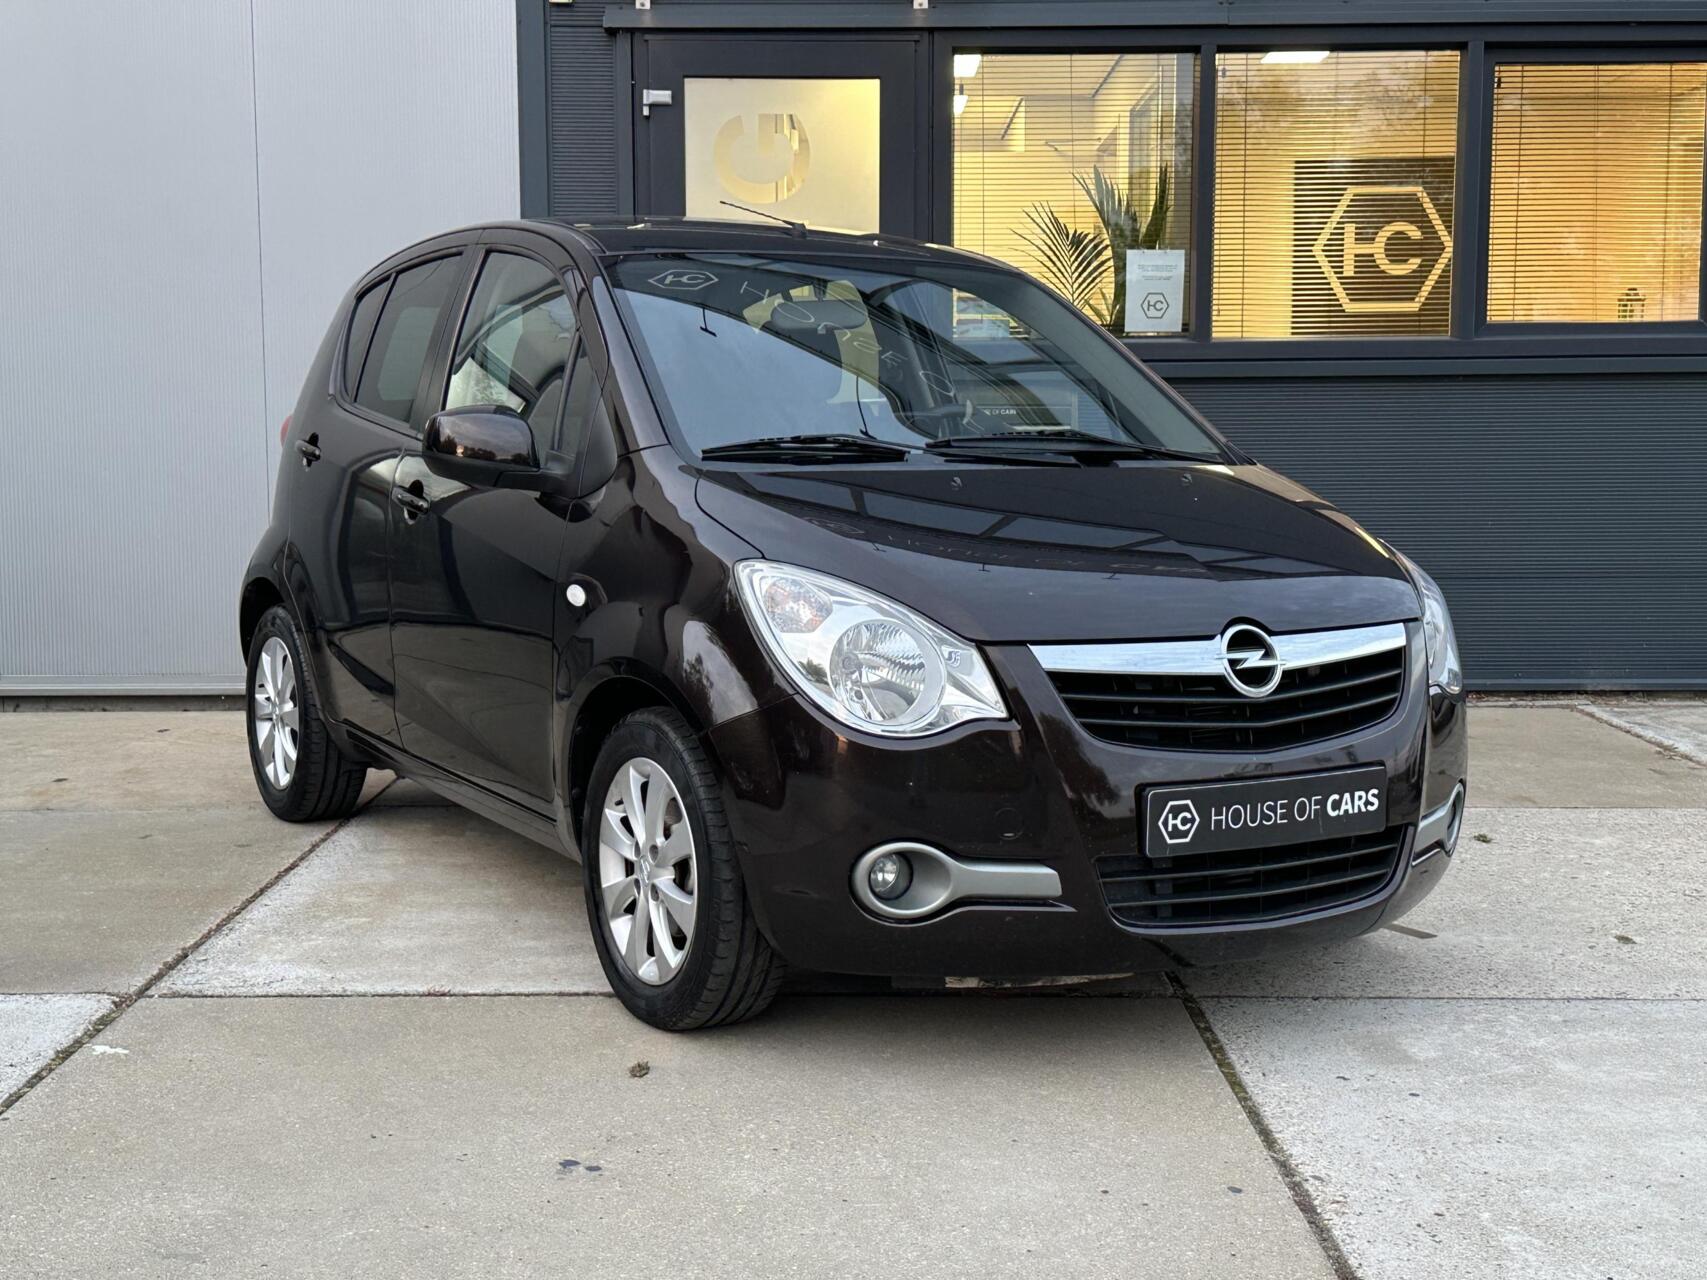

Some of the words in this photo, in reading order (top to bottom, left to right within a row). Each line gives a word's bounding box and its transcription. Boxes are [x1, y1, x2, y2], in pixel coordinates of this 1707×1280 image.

[1211, 800, 1288, 831] HOUSE
[1294, 796, 1322, 822] OF
[1326, 789, 1380, 817] CARS
